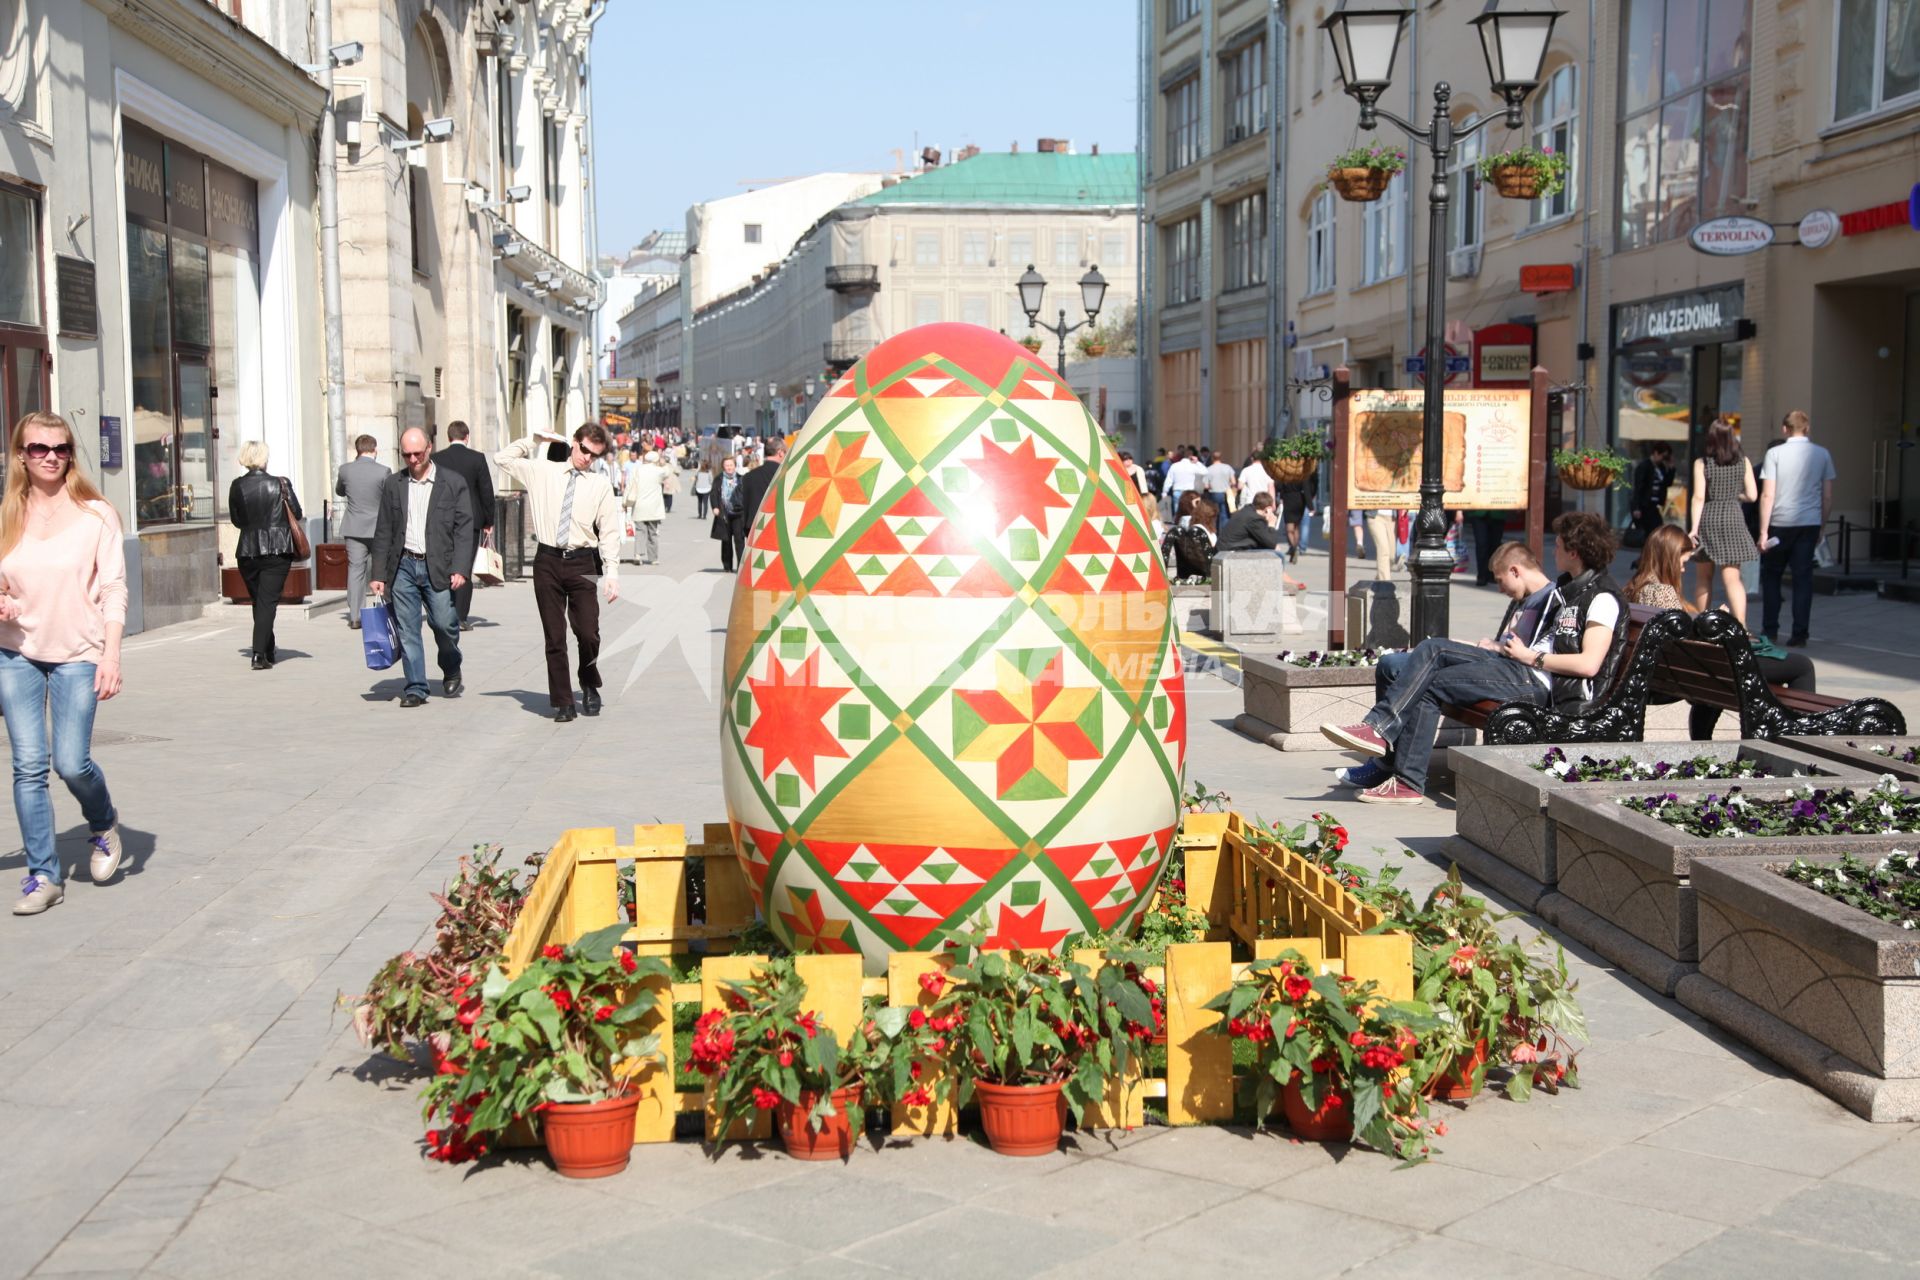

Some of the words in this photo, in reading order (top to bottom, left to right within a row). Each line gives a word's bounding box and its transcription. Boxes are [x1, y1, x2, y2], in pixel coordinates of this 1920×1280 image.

[212, 187, 256, 231] ЭКОНИКА
[1699, 230, 1767, 242] TERVOLINA
[1648, 302, 1721, 336] CALZEDONIA
[1483, 355, 1529, 364] LONDON
[1488, 363, 1522, 371] GRILL
